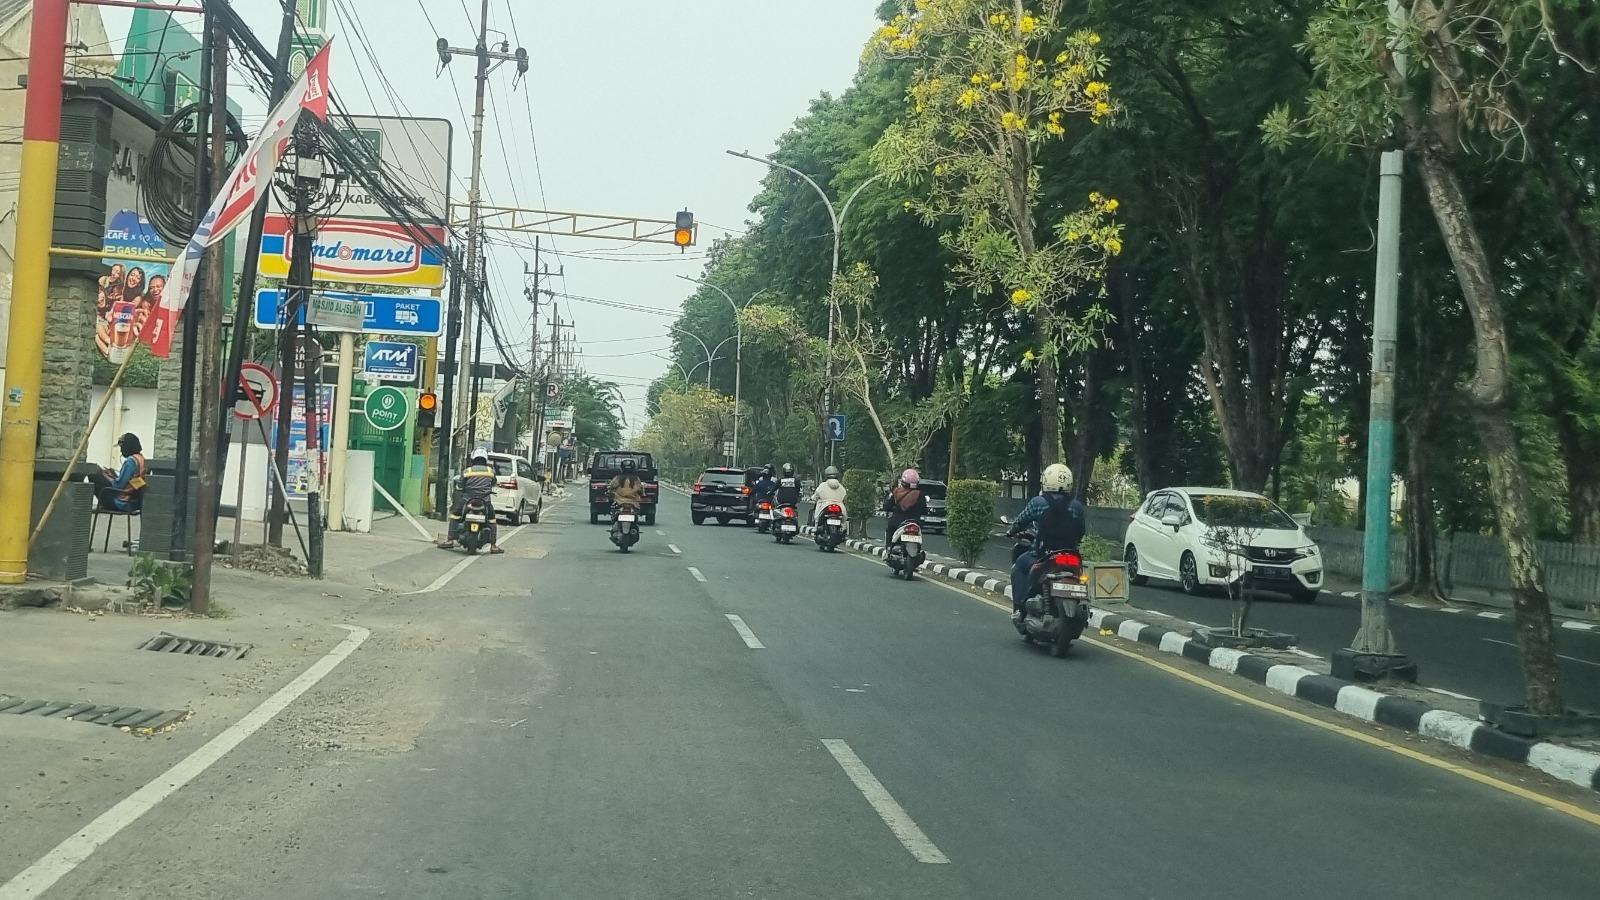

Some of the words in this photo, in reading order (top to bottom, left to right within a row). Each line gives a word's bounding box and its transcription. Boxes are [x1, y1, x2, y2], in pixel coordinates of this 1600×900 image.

[347, 194, 376, 204] KAB.
[311, 241, 414, 264] ndomaret
[312, 299, 335, 311] MASJID
[395, 303, 420, 311] PAKET
